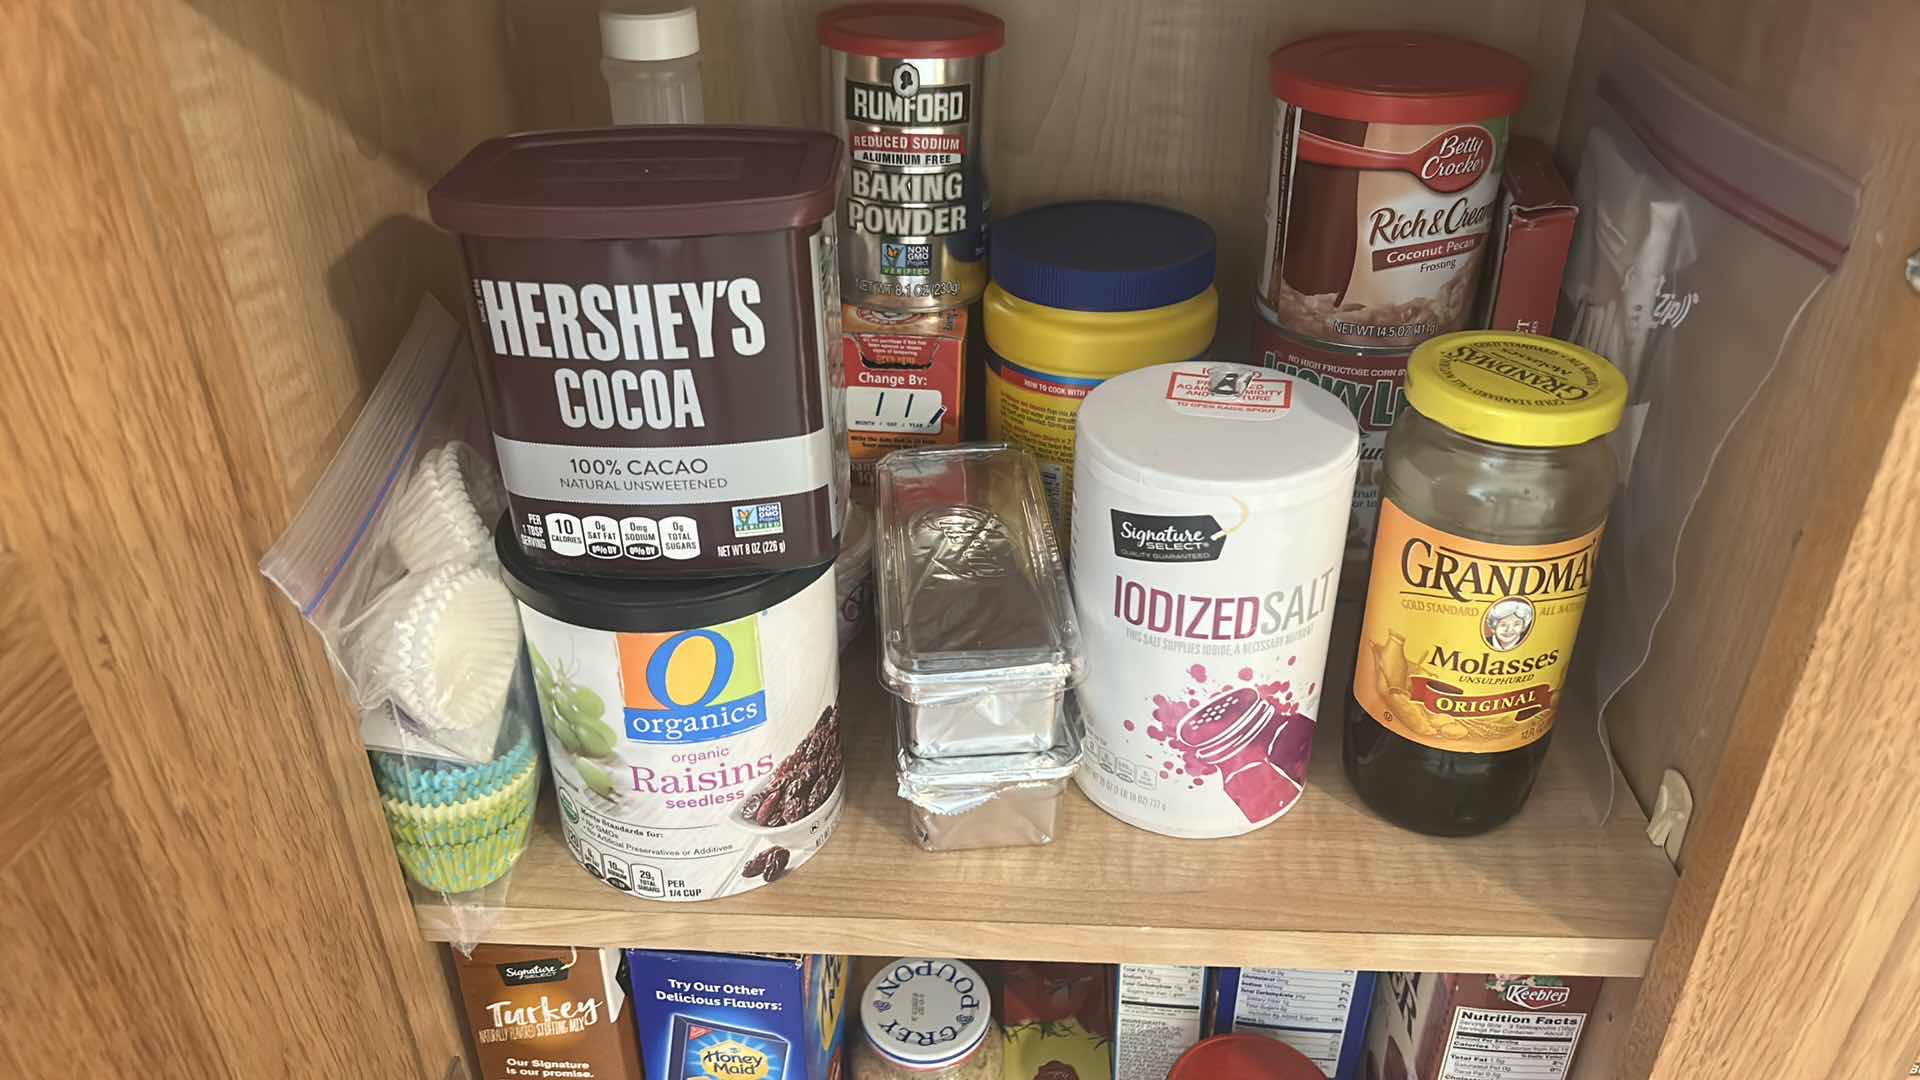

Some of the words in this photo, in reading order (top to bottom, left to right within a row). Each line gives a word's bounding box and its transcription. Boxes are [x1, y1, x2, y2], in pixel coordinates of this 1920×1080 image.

[854, 87, 963, 123] RUMFORD
[854, 134, 907, 150] REDUCED
[911, 135, 960, 150] SODIUM
[1440, 135, 1483, 159] Betty
[862, 151, 921, 165] ALUMINUM
[925, 153, 952, 165] FREE
[852, 169, 963, 202] BAKING
[849, 201, 967, 235] POWDER
[1369, 207, 1425, 246] Rich
[1428, 209, 1444, 236] &
[1387, 245, 1442, 263] Coconut
[1446, 239, 1475, 252] Pecan
[882, 267, 930, 275] VERIFIED
[1420, 259, 1456, 273] Frosting
[895, 284, 911, 297] 8.1
[480, 278, 767, 361] HERSHEY'S
[1334, 319, 1354, 334] NET
[1357, 325, 1375, 337] WT
[1288, 355, 1300, 364] NO
[1300, 358, 1321, 370] HIGH
[1322, 362, 1370, 377] FRUCTOSE
[1370, 369, 1397, 377] CORN
[858, 372, 905, 387] Change
[1177, 383, 1212, 391] AGAIN
[1038, 383, 1047, 392] TO
[1048, 385, 1066, 395] COOK
[554, 367, 705, 430] COCOA
[570, 458, 622, 475] 100%
[627, 458, 708, 475] CACAO
[560, 478, 620, 491] NATURAL
[624, 478, 728, 491] UNSWEETENED
[758, 504, 778, 512] NON
[527, 513, 543, 526] PER
[555, 518, 573, 534] 10
[595, 521, 606, 531] 0g
[630, 522, 648, 532] 0mg
[672, 521, 684, 532] 0g
[527, 525, 543, 537] TBSP
[551, 534, 582, 544] CALORIES
[588, 531, 601, 540] SAT
[603, 532, 616, 540] FAT
[625, 533, 656, 541] SODIUM
[668, 533, 692, 541] TOTAL
[1121, 521, 1205, 547] Signature
[665, 541, 697, 550] SUGARS
[717, 545, 731, 557] NET
[731, 544, 744, 556] WT
[751, 542, 761, 554] OZ
[1121, 548, 1151, 558] QUALITY
[1114, 574, 1260, 640] IODIZED
[1261, 568, 1334, 635] SALT
[1401, 599, 1425, 611] GOLD
[1425, 600, 1479, 616] STANDARD
[1539, 605, 1556, 616] ALL
[1126, 627, 1142, 643] THIS
[1143, 632, 1161, 648] SALT
[1161, 637, 1201, 655] SUPPLIES
[1242, 635, 1284, 654] NECESSARY
[1429, 645, 1560, 675] Molasses
[646, 629, 734, 711] O
[1459, 674, 1535, 685] UNSULPHURED
[1436, 690, 1537, 713] ORIGINAL
[632, 702, 758, 740] organics
[671, 746, 730, 765] organic
[628, 753, 775, 794] Raisins
[665, 789, 745, 809] seedless
[580, 807, 602, 825] Meets
[602, 820, 644, 838] Standards
[646, 829, 665, 839] for:
[596, 824, 620, 839] GMOs
[625, 842, 681, 857] Preservatives
[693, 844, 734, 856] Additives
[668, 880, 685, 888] PER
[669, 889, 682, 897] 1/4
[683, 889, 701, 897] CUP
[506, 965, 557, 980] Signature
[668, 979, 692, 992] Try
[694, 982, 721, 993] Our
[723, 985, 766, 996] Other
[876, 960, 980, 1010] POUPON
[656, 991, 721, 1006] Delicious
[723, 998, 782, 1011] Flavors:
[1509, 984, 1566, 1003] Keebler
[486, 996, 604, 1027] Turkey
[1461, 1011, 1531, 1024] Nutrition
[1535, 1016, 1578, 1025] Facts
[536, 1020, 569, 1037] STUFFING
[569, 1017, 586, 1033] MIX
[879, 1018, 959, 1047] GREY
[506, 1058, 528, 1067] Our
[531, 1058, 590, 1070] Signature
[703, 1051, 763, 1068] Honey
[519, 1068, 540, 1076] our
[542, 1069, 594, 1078] promise.
[714, 1063, 756, 1075] Maid
